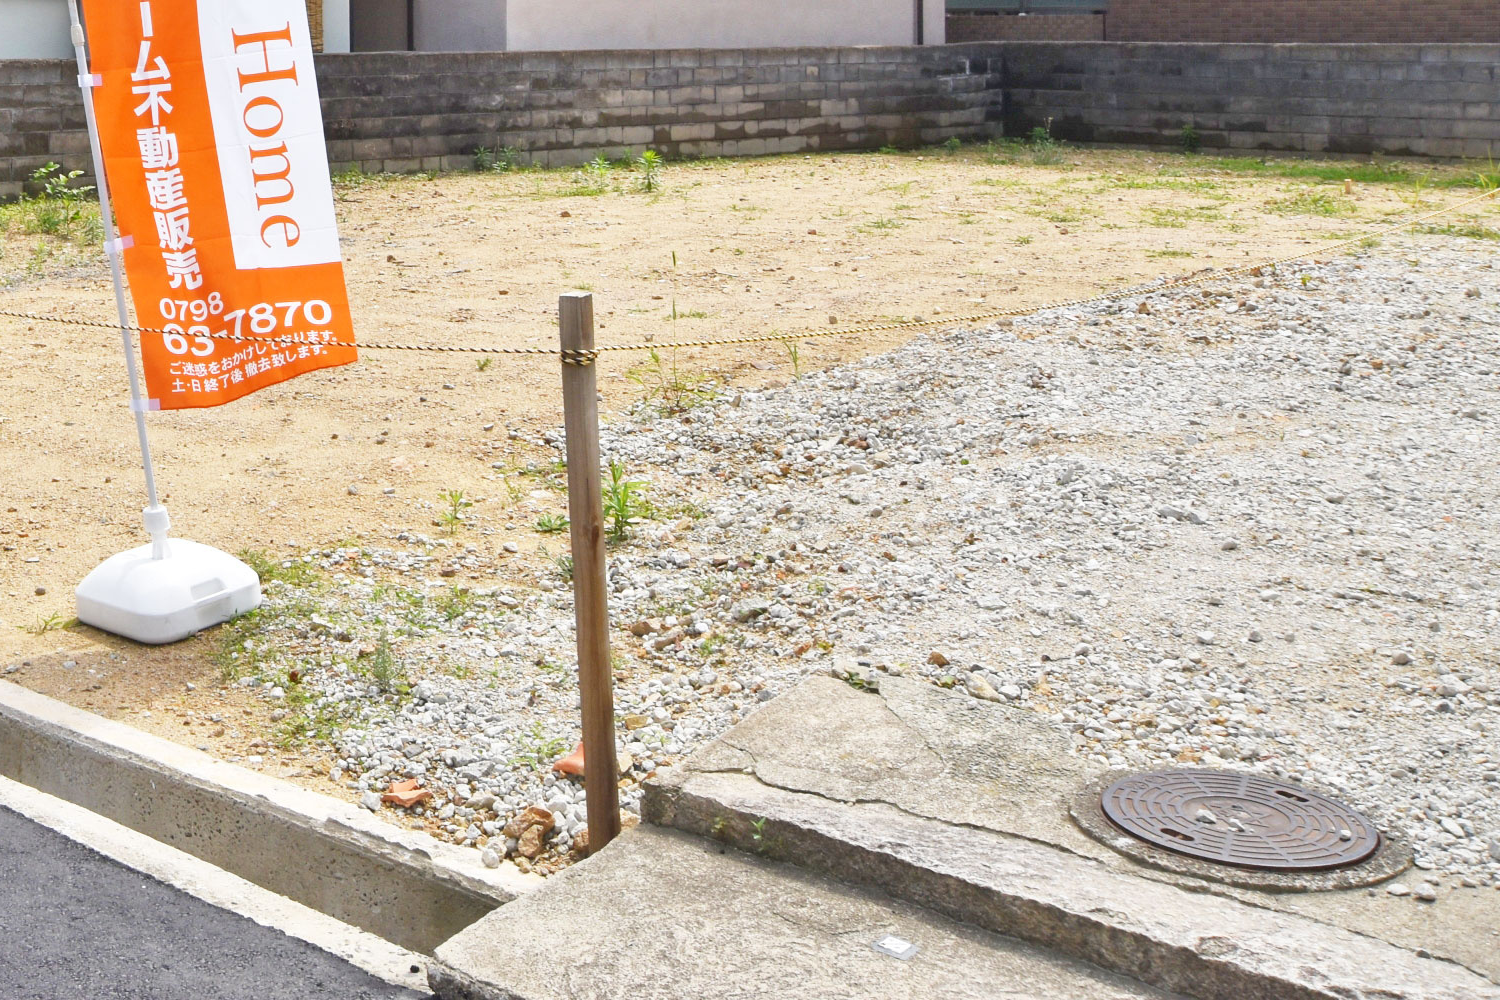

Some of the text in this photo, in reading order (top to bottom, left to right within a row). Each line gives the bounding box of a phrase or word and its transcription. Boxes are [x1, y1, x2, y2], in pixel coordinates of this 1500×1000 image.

[231, 19, 301, 249] Home
[159, 291, 223, 322] 0798
[162, 299, 332, 357] 63-7870
